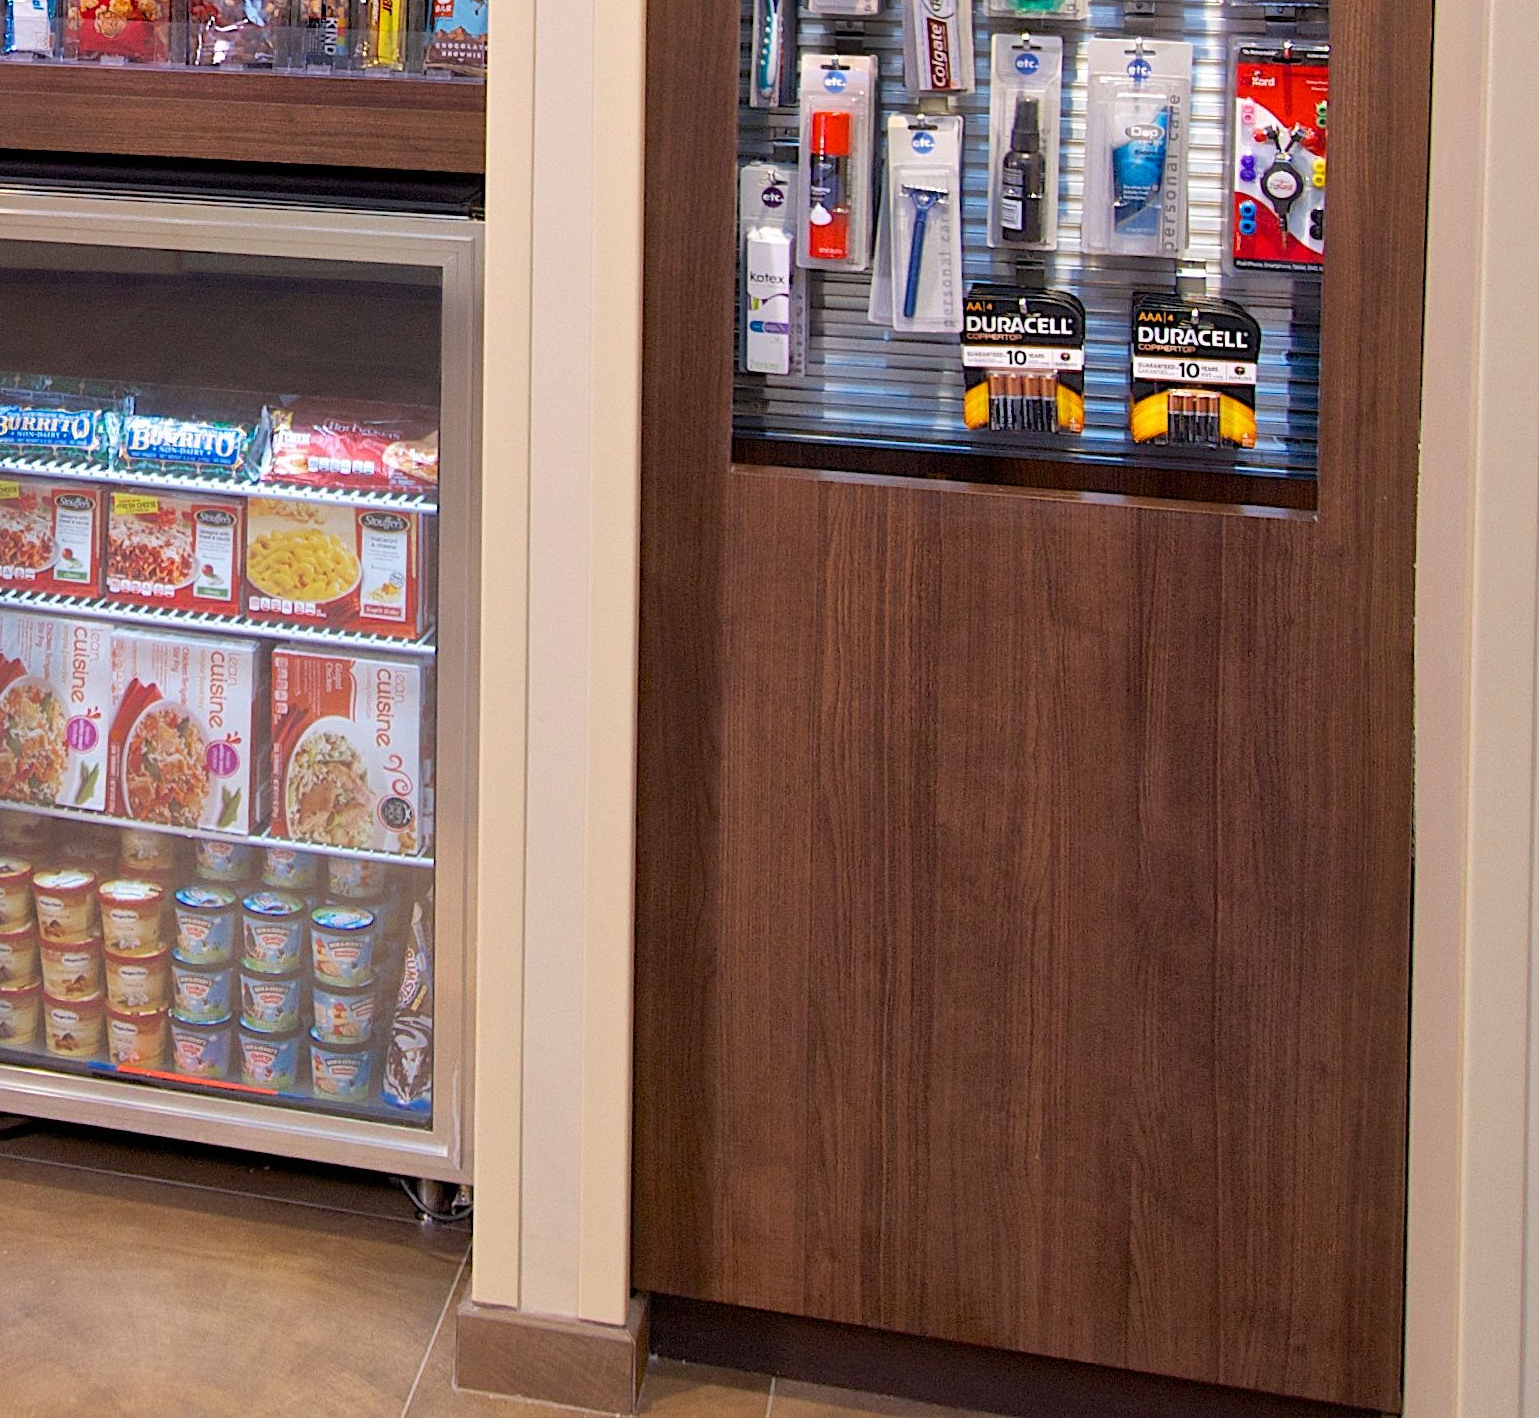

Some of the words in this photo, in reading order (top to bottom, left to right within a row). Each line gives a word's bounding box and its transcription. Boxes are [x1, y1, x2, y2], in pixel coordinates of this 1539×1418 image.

[324, 17, 338, 56] KIND
[441, 51, 482, 59] BROWNIE
[931, 22, 946, 88] Colgate
[1016, 59, 1039, 68] etc.
[1128, 65, 1152, 75] etc.
[824, 78, 847, 87] etc.
[1168, 94, 1180, 143] care
[1130, 126, 1159, 139] Dep
[913, 139, 936, 149] etc.
[762, 193, 785, 202] etc.
[1163, 151, 1179, 252] personal
[750, 272, 785, 285] kotex
[966, 317, 1072, 335] DURACELL
[966, 333, 1022, 341] COPPERTOP
[1138, 327, 1248, 349] DURACELL
[1138, 344, 1196, 353] COPPERTOP
[1007, 351, 1027, 365] 10
[1179, 363, 1200, 378] 10
[17, 431, 61, 439] NON-DAIRY
[129, 428, 236, 457] BURRITO
[159, 446, 205, 457] NON-DAIRY
[59, 497, 91, 510] Stouffer's
[198, 512, 232, 524] Stouffer's
[364, 515, 404, 530] Stouffer's
[71, 627, 88, 703] cuisine
[228, 653, 241, 687] lean
[209, 651, 226, 729] cuisine
[395, 669, 410, 705] lean
[376, 668, 394, 748] cuisine
